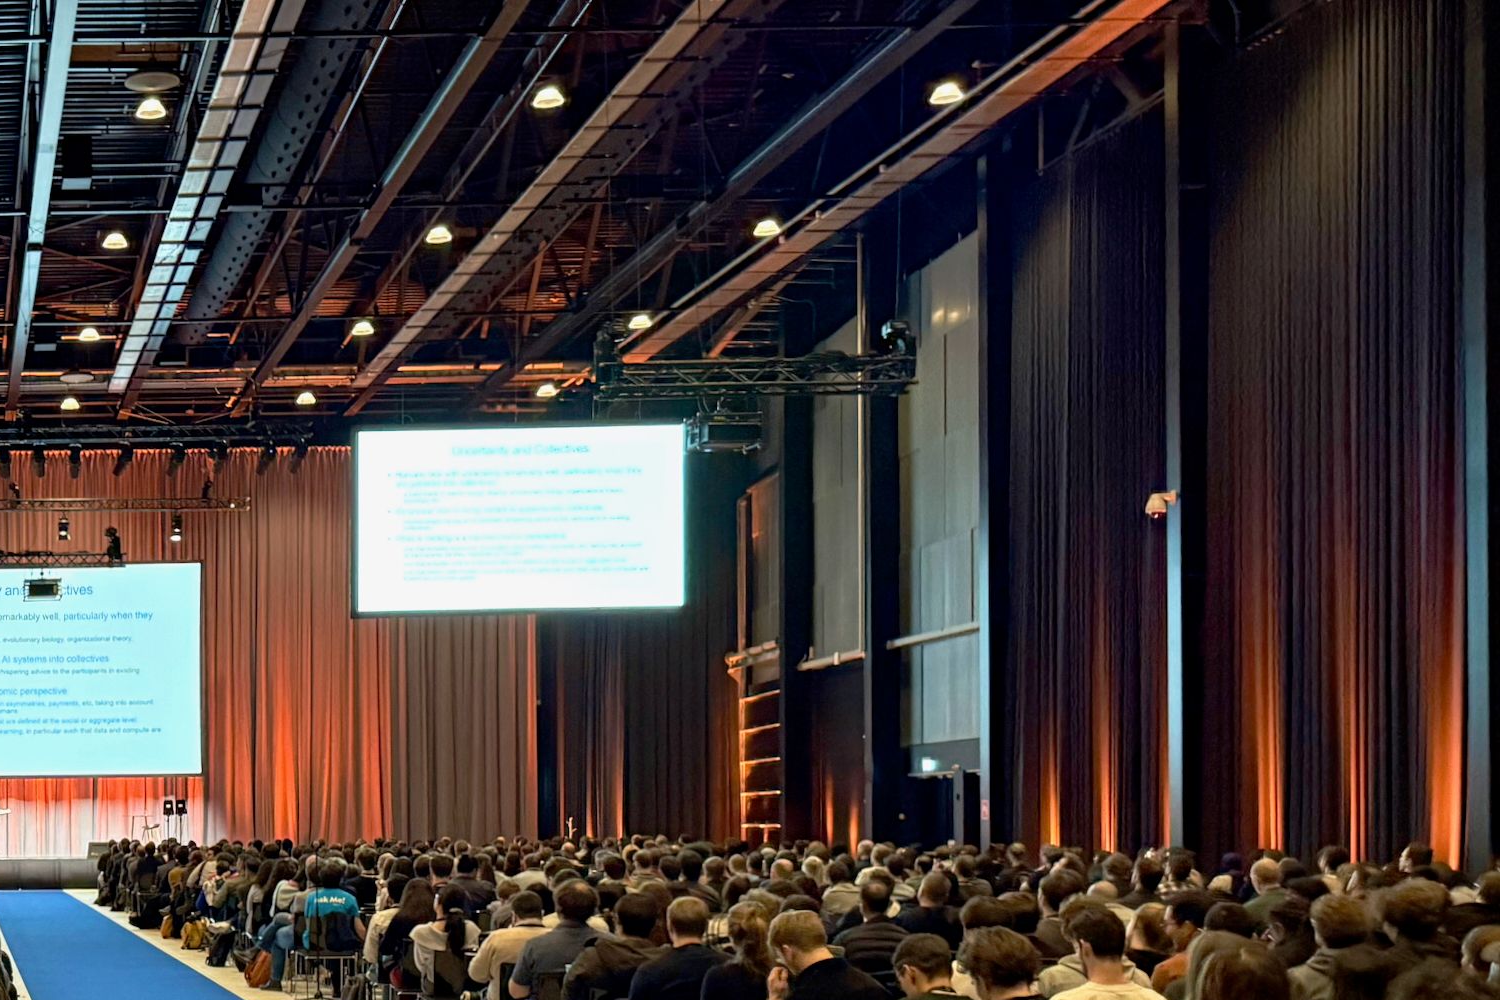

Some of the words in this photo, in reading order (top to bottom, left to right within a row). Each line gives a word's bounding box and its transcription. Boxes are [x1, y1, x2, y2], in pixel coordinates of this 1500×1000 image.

[64, 612, 108, 621] particularly
[135, 611, 152, 621] they
[2, 656, 10, 664] AI
[13, 656, 46, 665] systems
[67, 655, 109, 663] collectives
[20, 688, 67, 696] perspective
